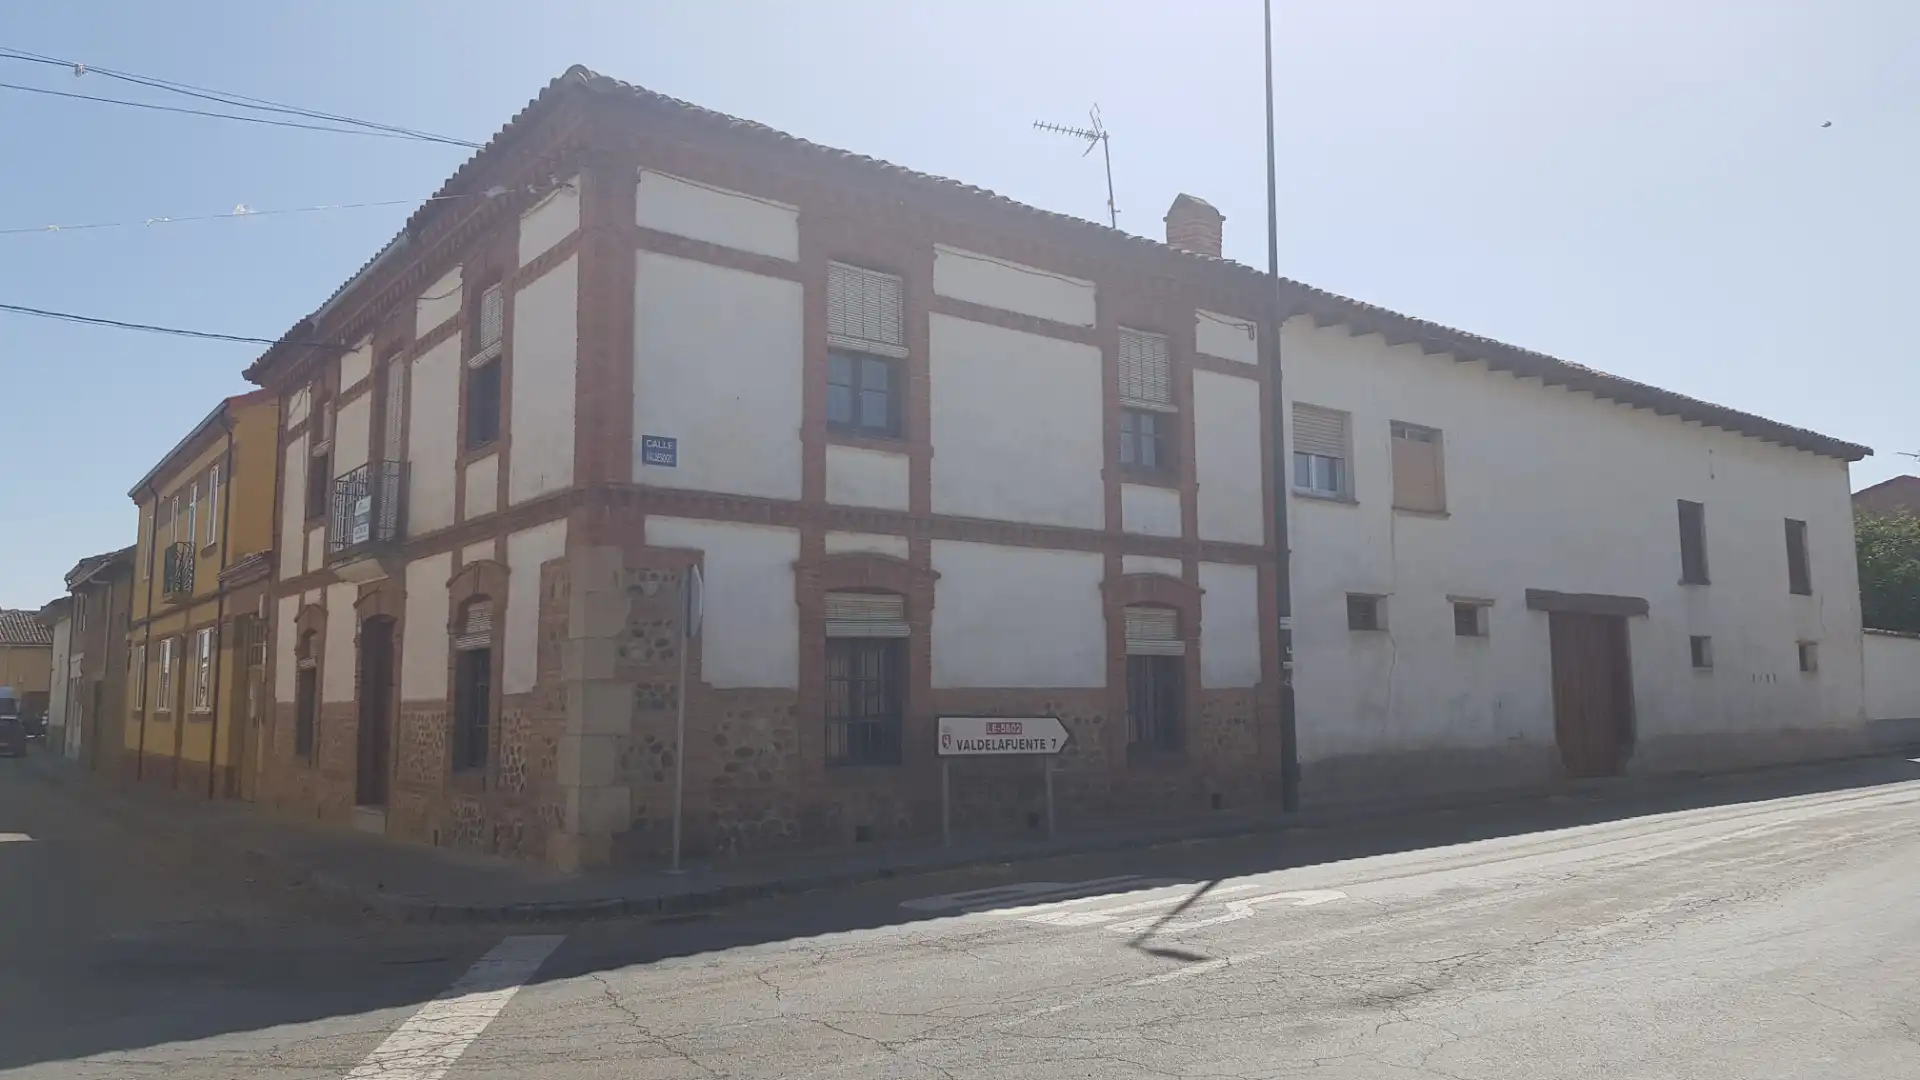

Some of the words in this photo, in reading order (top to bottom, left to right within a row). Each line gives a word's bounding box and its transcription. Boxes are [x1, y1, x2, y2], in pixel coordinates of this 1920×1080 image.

[646, 439, 674, 450] CALLE
[956, 738, 1046, 752] VALDELAFUENTE
[1051, 738, 1057, 749] 7
